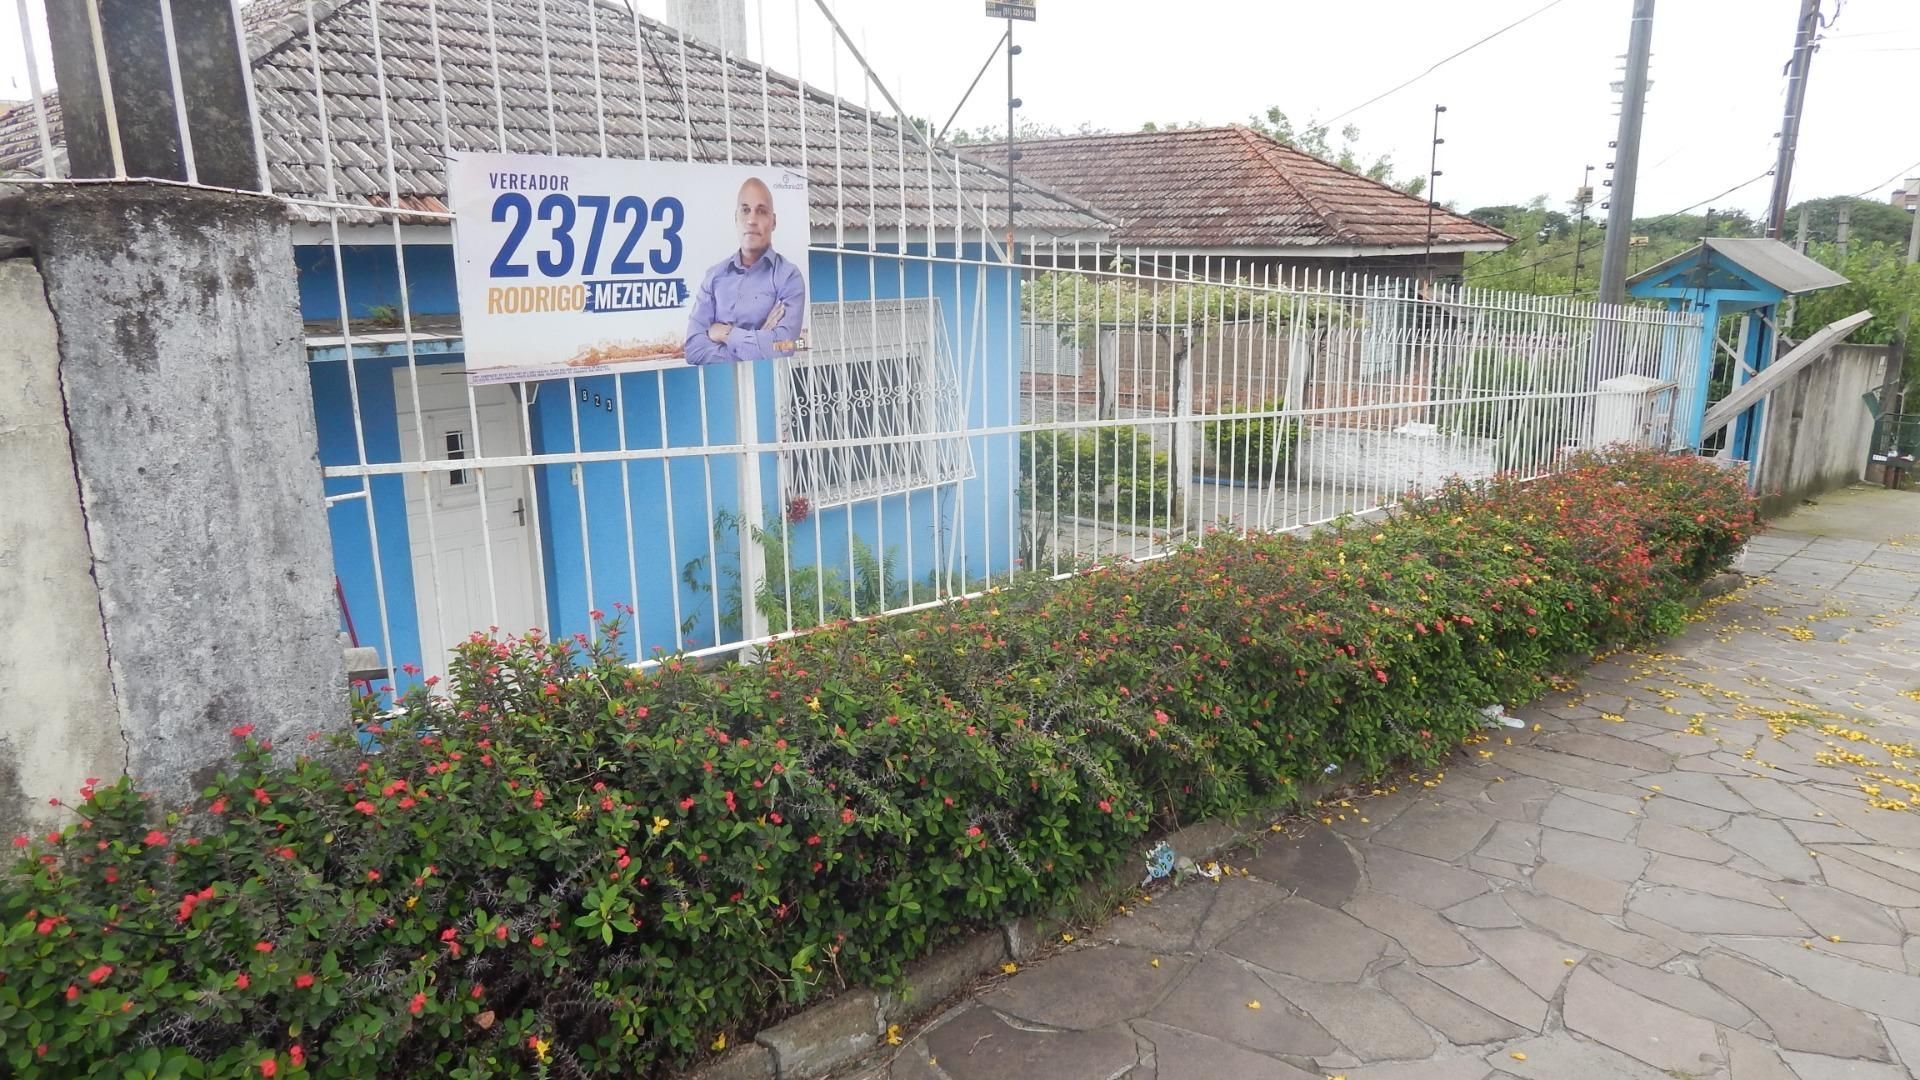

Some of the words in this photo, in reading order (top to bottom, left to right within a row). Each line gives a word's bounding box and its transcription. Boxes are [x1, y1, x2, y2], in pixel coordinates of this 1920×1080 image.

[489, 172, 569, 190] VEREADOR
[490, 192, 685, 277] 23723
[488, 284, 585, 314] RODRIGO
[594, 281, 679, 310] MEZENGA
